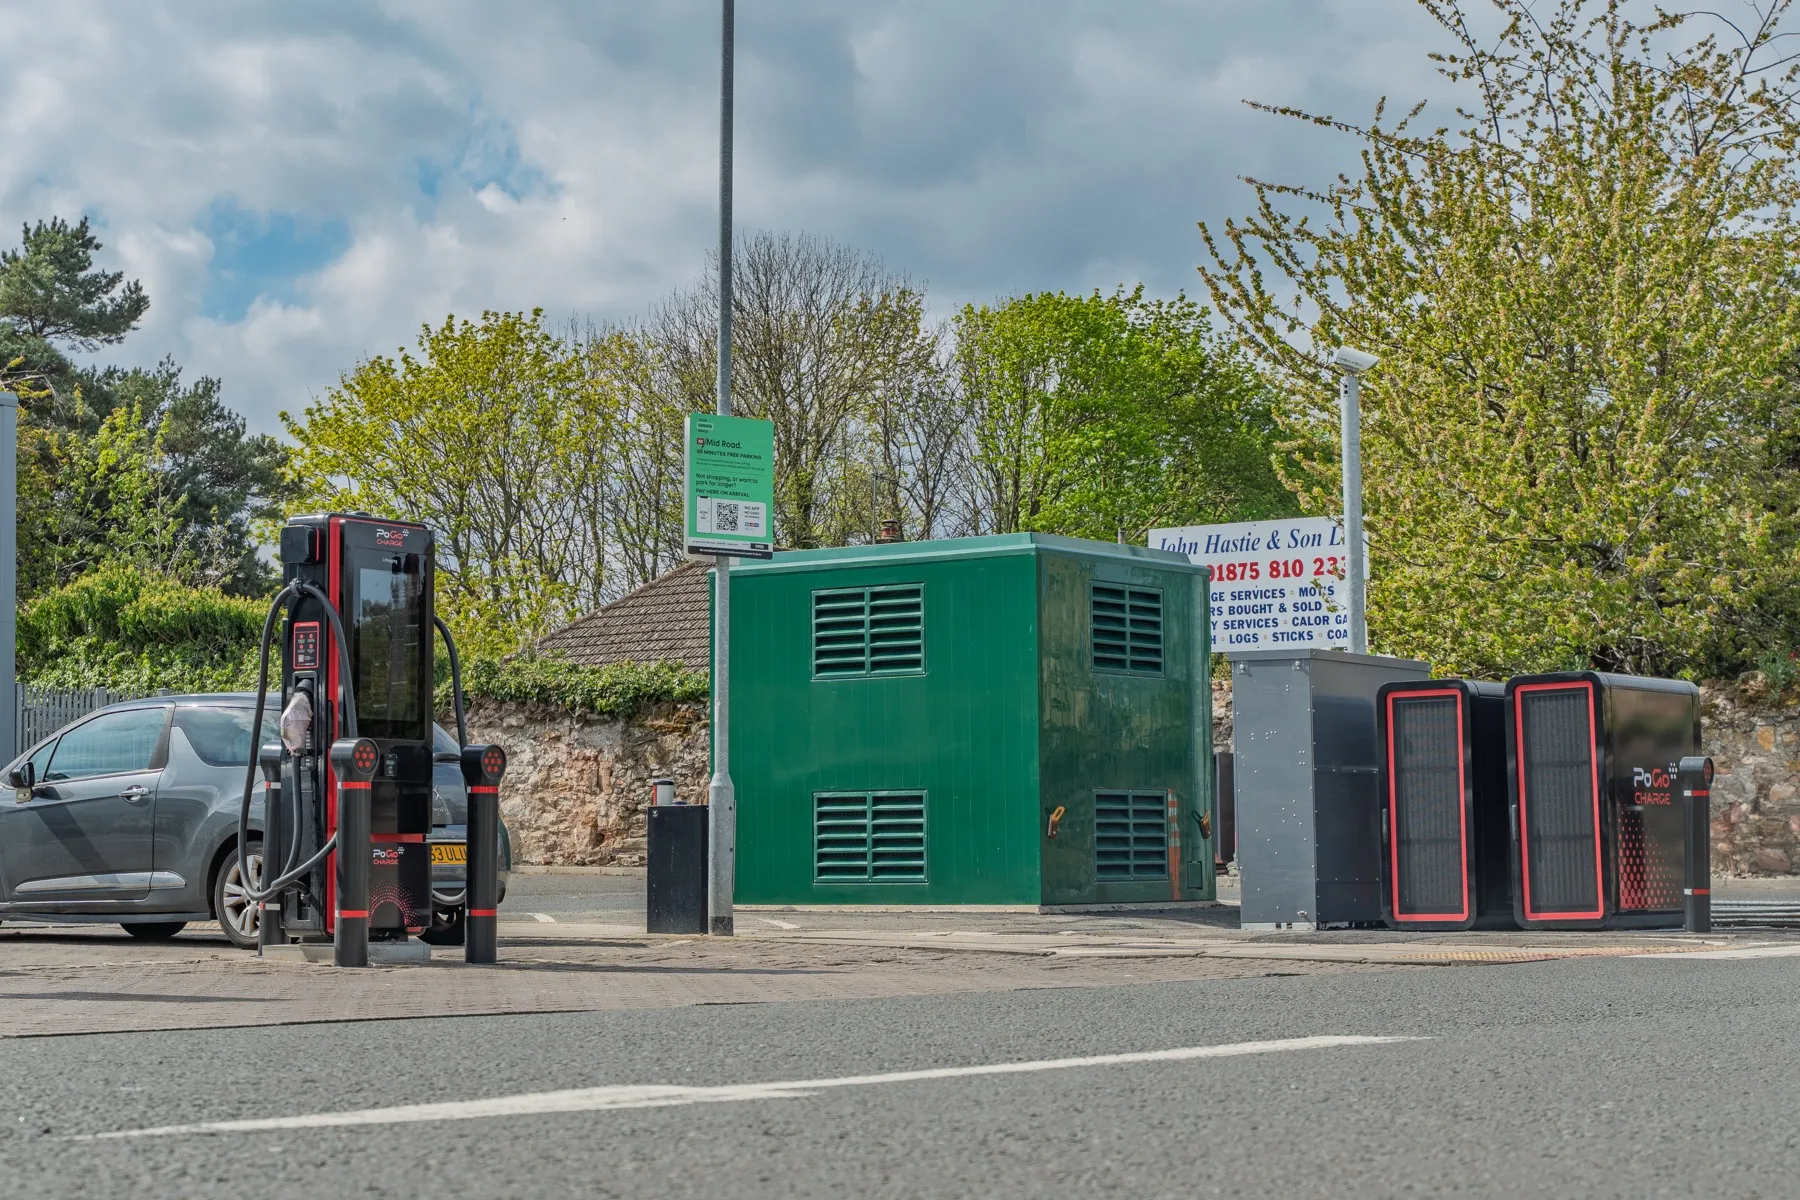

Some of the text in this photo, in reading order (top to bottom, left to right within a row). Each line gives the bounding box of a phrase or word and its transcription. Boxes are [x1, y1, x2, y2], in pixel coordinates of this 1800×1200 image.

[706, 438, 720, 447] Mid
[704, 449, 726, 457] MINUTES
[706, 474, 731, 482] shopping,
[377, 539, 404, 547] CHARGE
[1160, 536, 1198, 555] John
[1204, 531, 1261, 554] Hastie
[1266, 529, 1281, 551] &
[1287, 528, 1322, 549] Son
[1269, 559, 1304, 579] 810
[1230, 588, 1286, 601] SERVICES
[1298, 585, 1335, 598] MOT'S
[1228, 604, 1273, 616] BOUGHT
[1278, 603, 1287, 613] &
[1292, 601, 1322, 612] SOLD
[1223, 618, 1279, 630] SERVICES
[1291, 615, 1330, 627] CALOR
[1335, 614, 1347, 625] GA
[1229, 633, 1259, 644] LOGS
[1272, 631, 1313, 642] STICKS
[1327, 629, 1347, 640] COA
[1634, 792, 1671, 805] CHARGE
